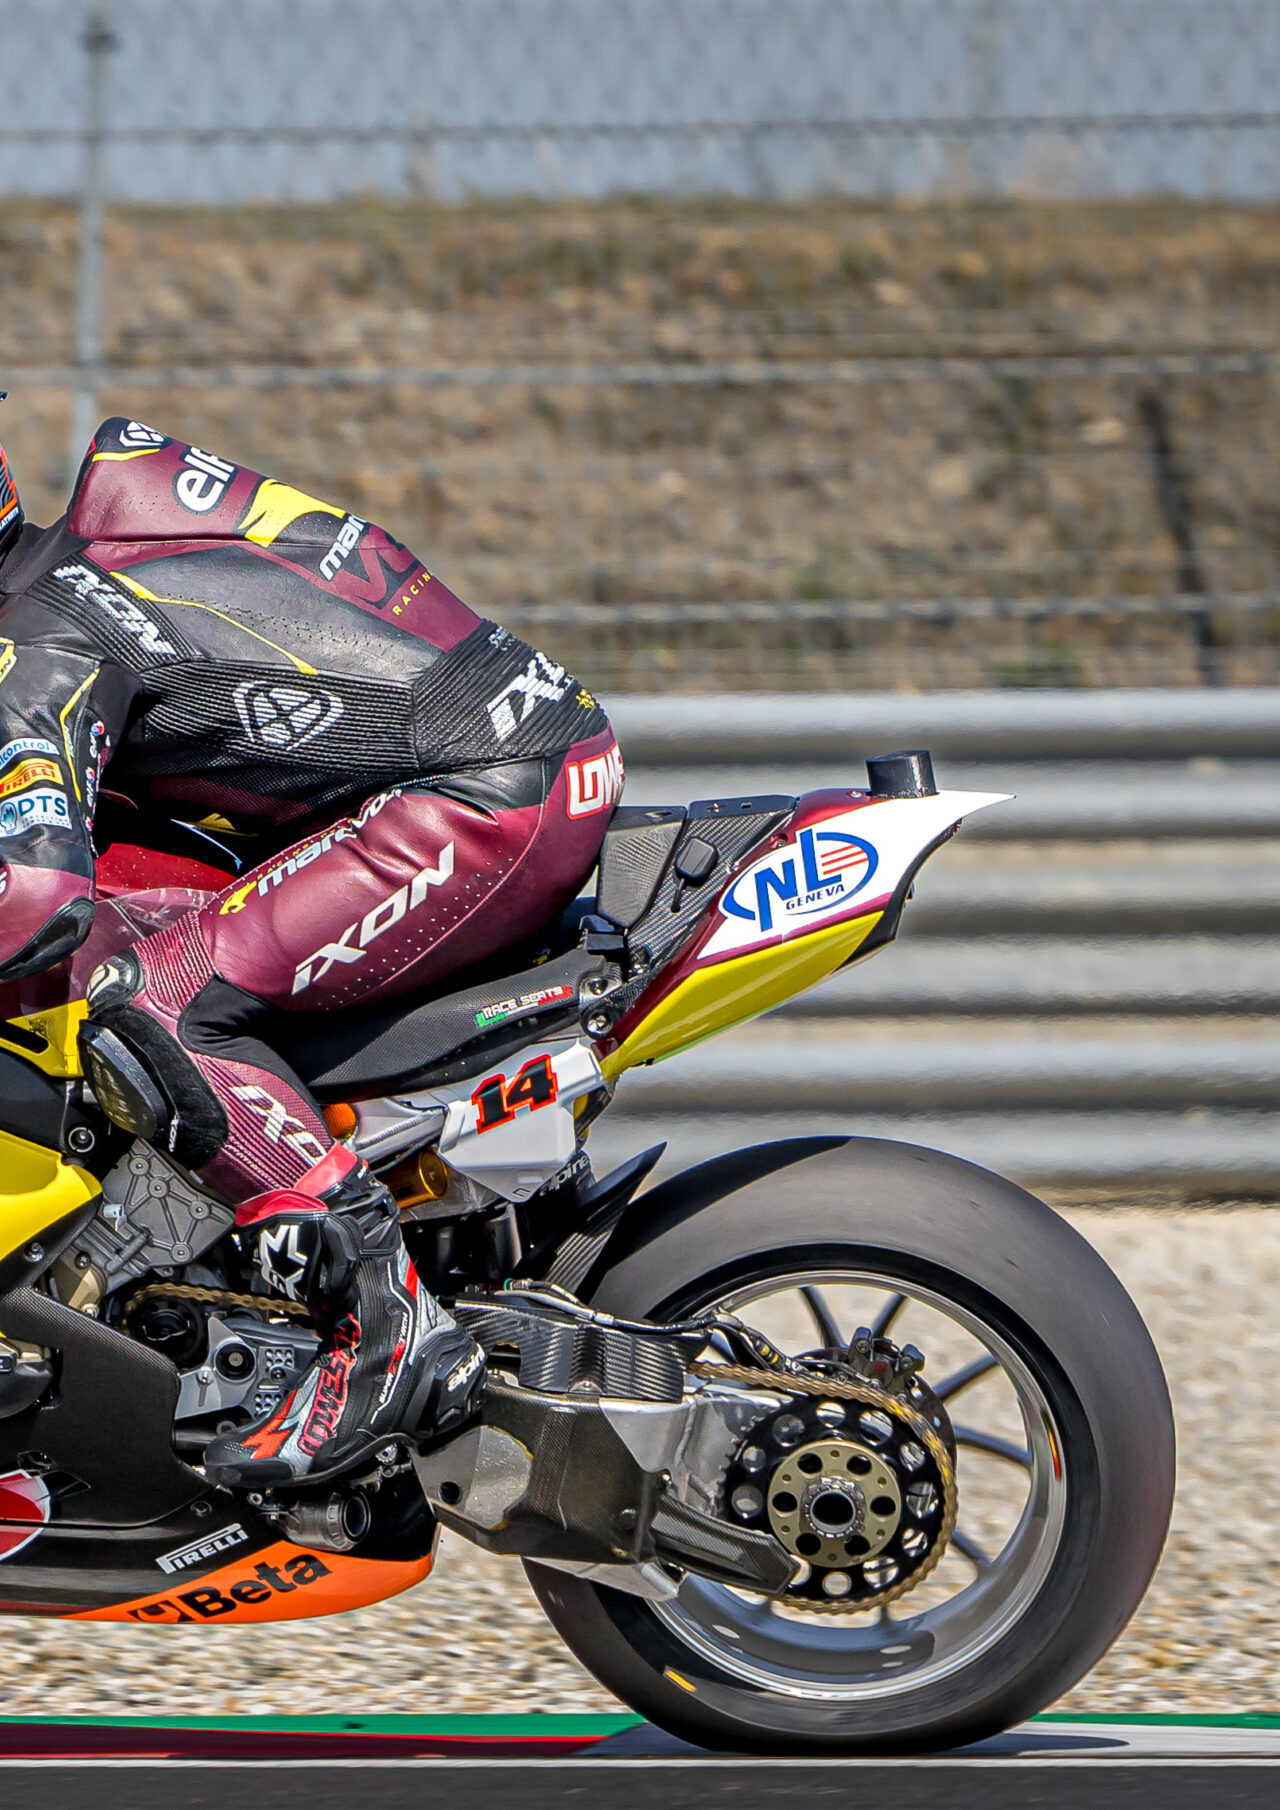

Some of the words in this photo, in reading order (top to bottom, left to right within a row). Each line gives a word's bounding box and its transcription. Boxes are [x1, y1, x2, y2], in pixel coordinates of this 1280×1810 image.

[392, 569, 434, 615] RACIN
[19, 796, 67, 816] DTS
[566, 743, 625, 818] LOWE
[291, 841, 454, 995] IXON
[786, 883, 845, 910] GENEVA
[482, 999, 518, 1018] RACE
[522, 986, 564, 1004] SEATS
[471, 1054, 559, 1135] 14
[229, 1085, 327, 1168] IXO
[448, 1343, 485, 1391] alpin
[155, 1523, 249, 1575] PIRELLI
[177, 1554, 333, 1618] Beta
